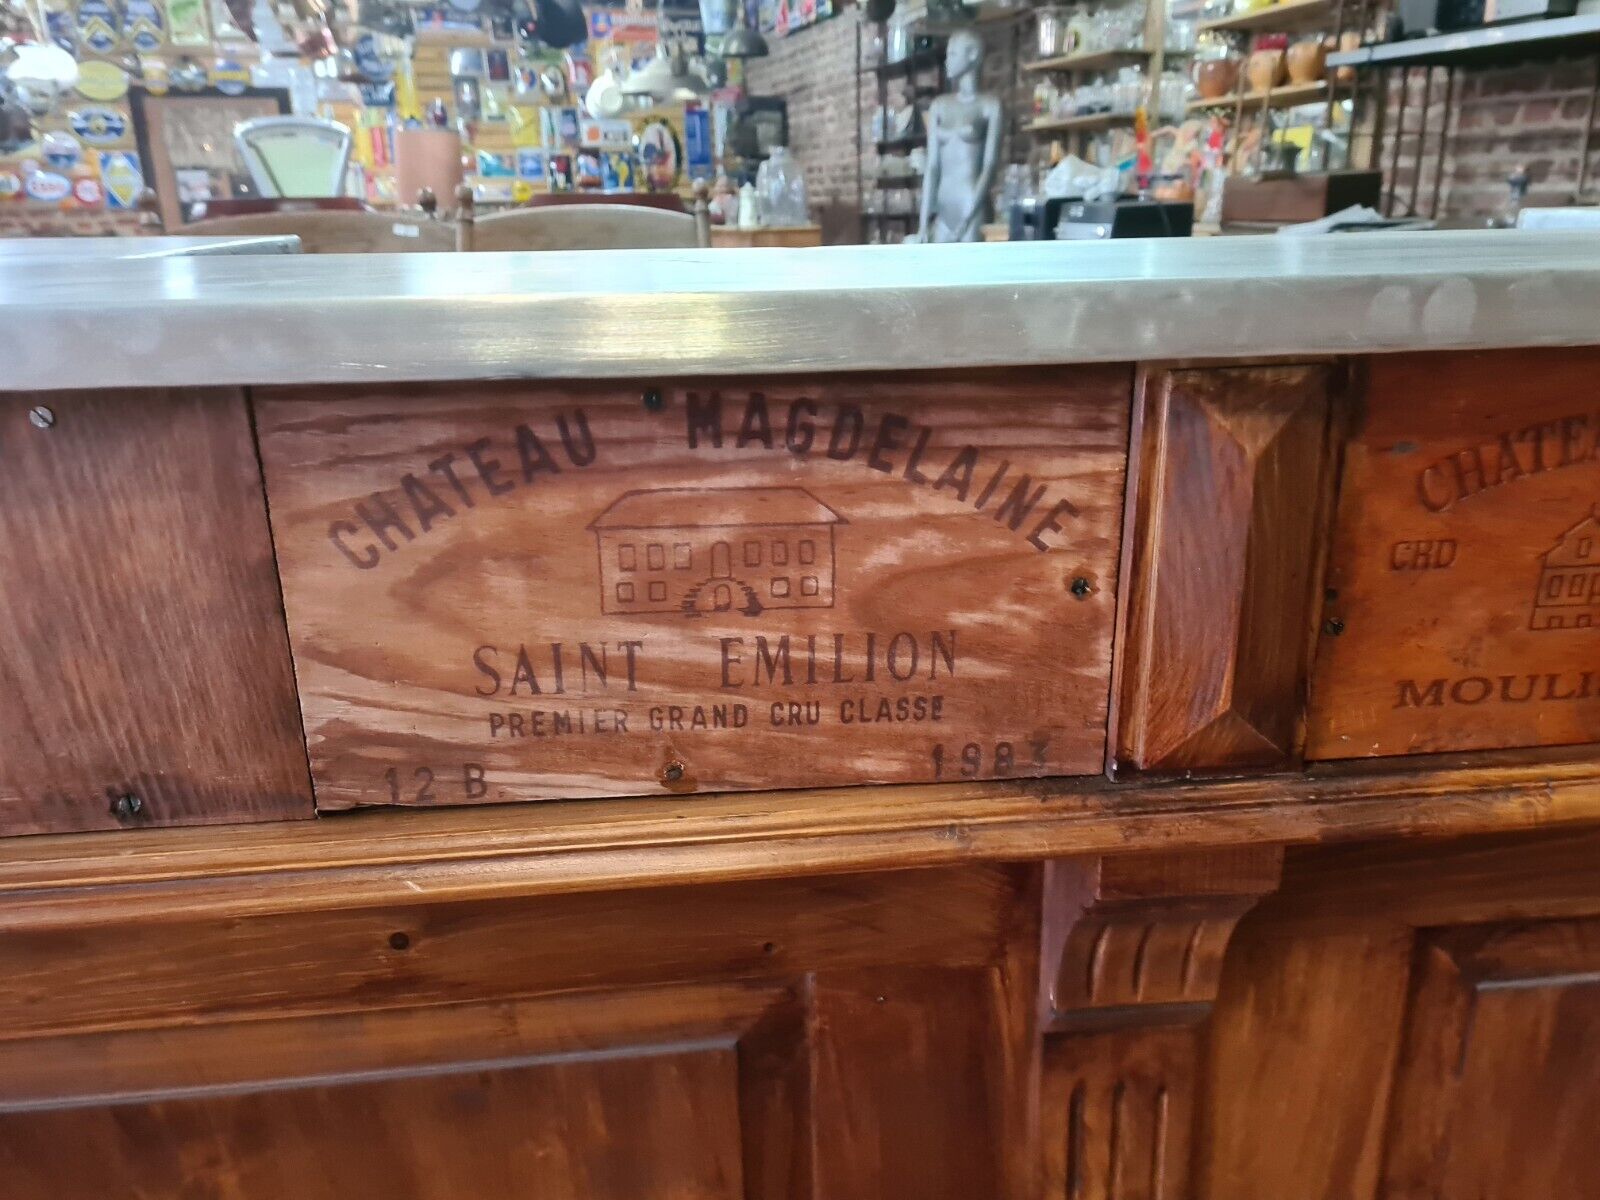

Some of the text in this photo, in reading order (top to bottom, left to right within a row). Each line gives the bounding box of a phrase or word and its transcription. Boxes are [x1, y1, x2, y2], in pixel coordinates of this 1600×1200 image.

[327, 390, 1080, 570] CHATEAU MAGDELAINE
[1417, 408, 1600, 513] CHATE
[473, 630, 959, 696] SAINT EMILION
[490, 695, 944, 738] PREMIER GRAND CRU CLASSE
[1391, 671, 1600, 710] MOULI
[384, 762, 488, 805] 12 B
